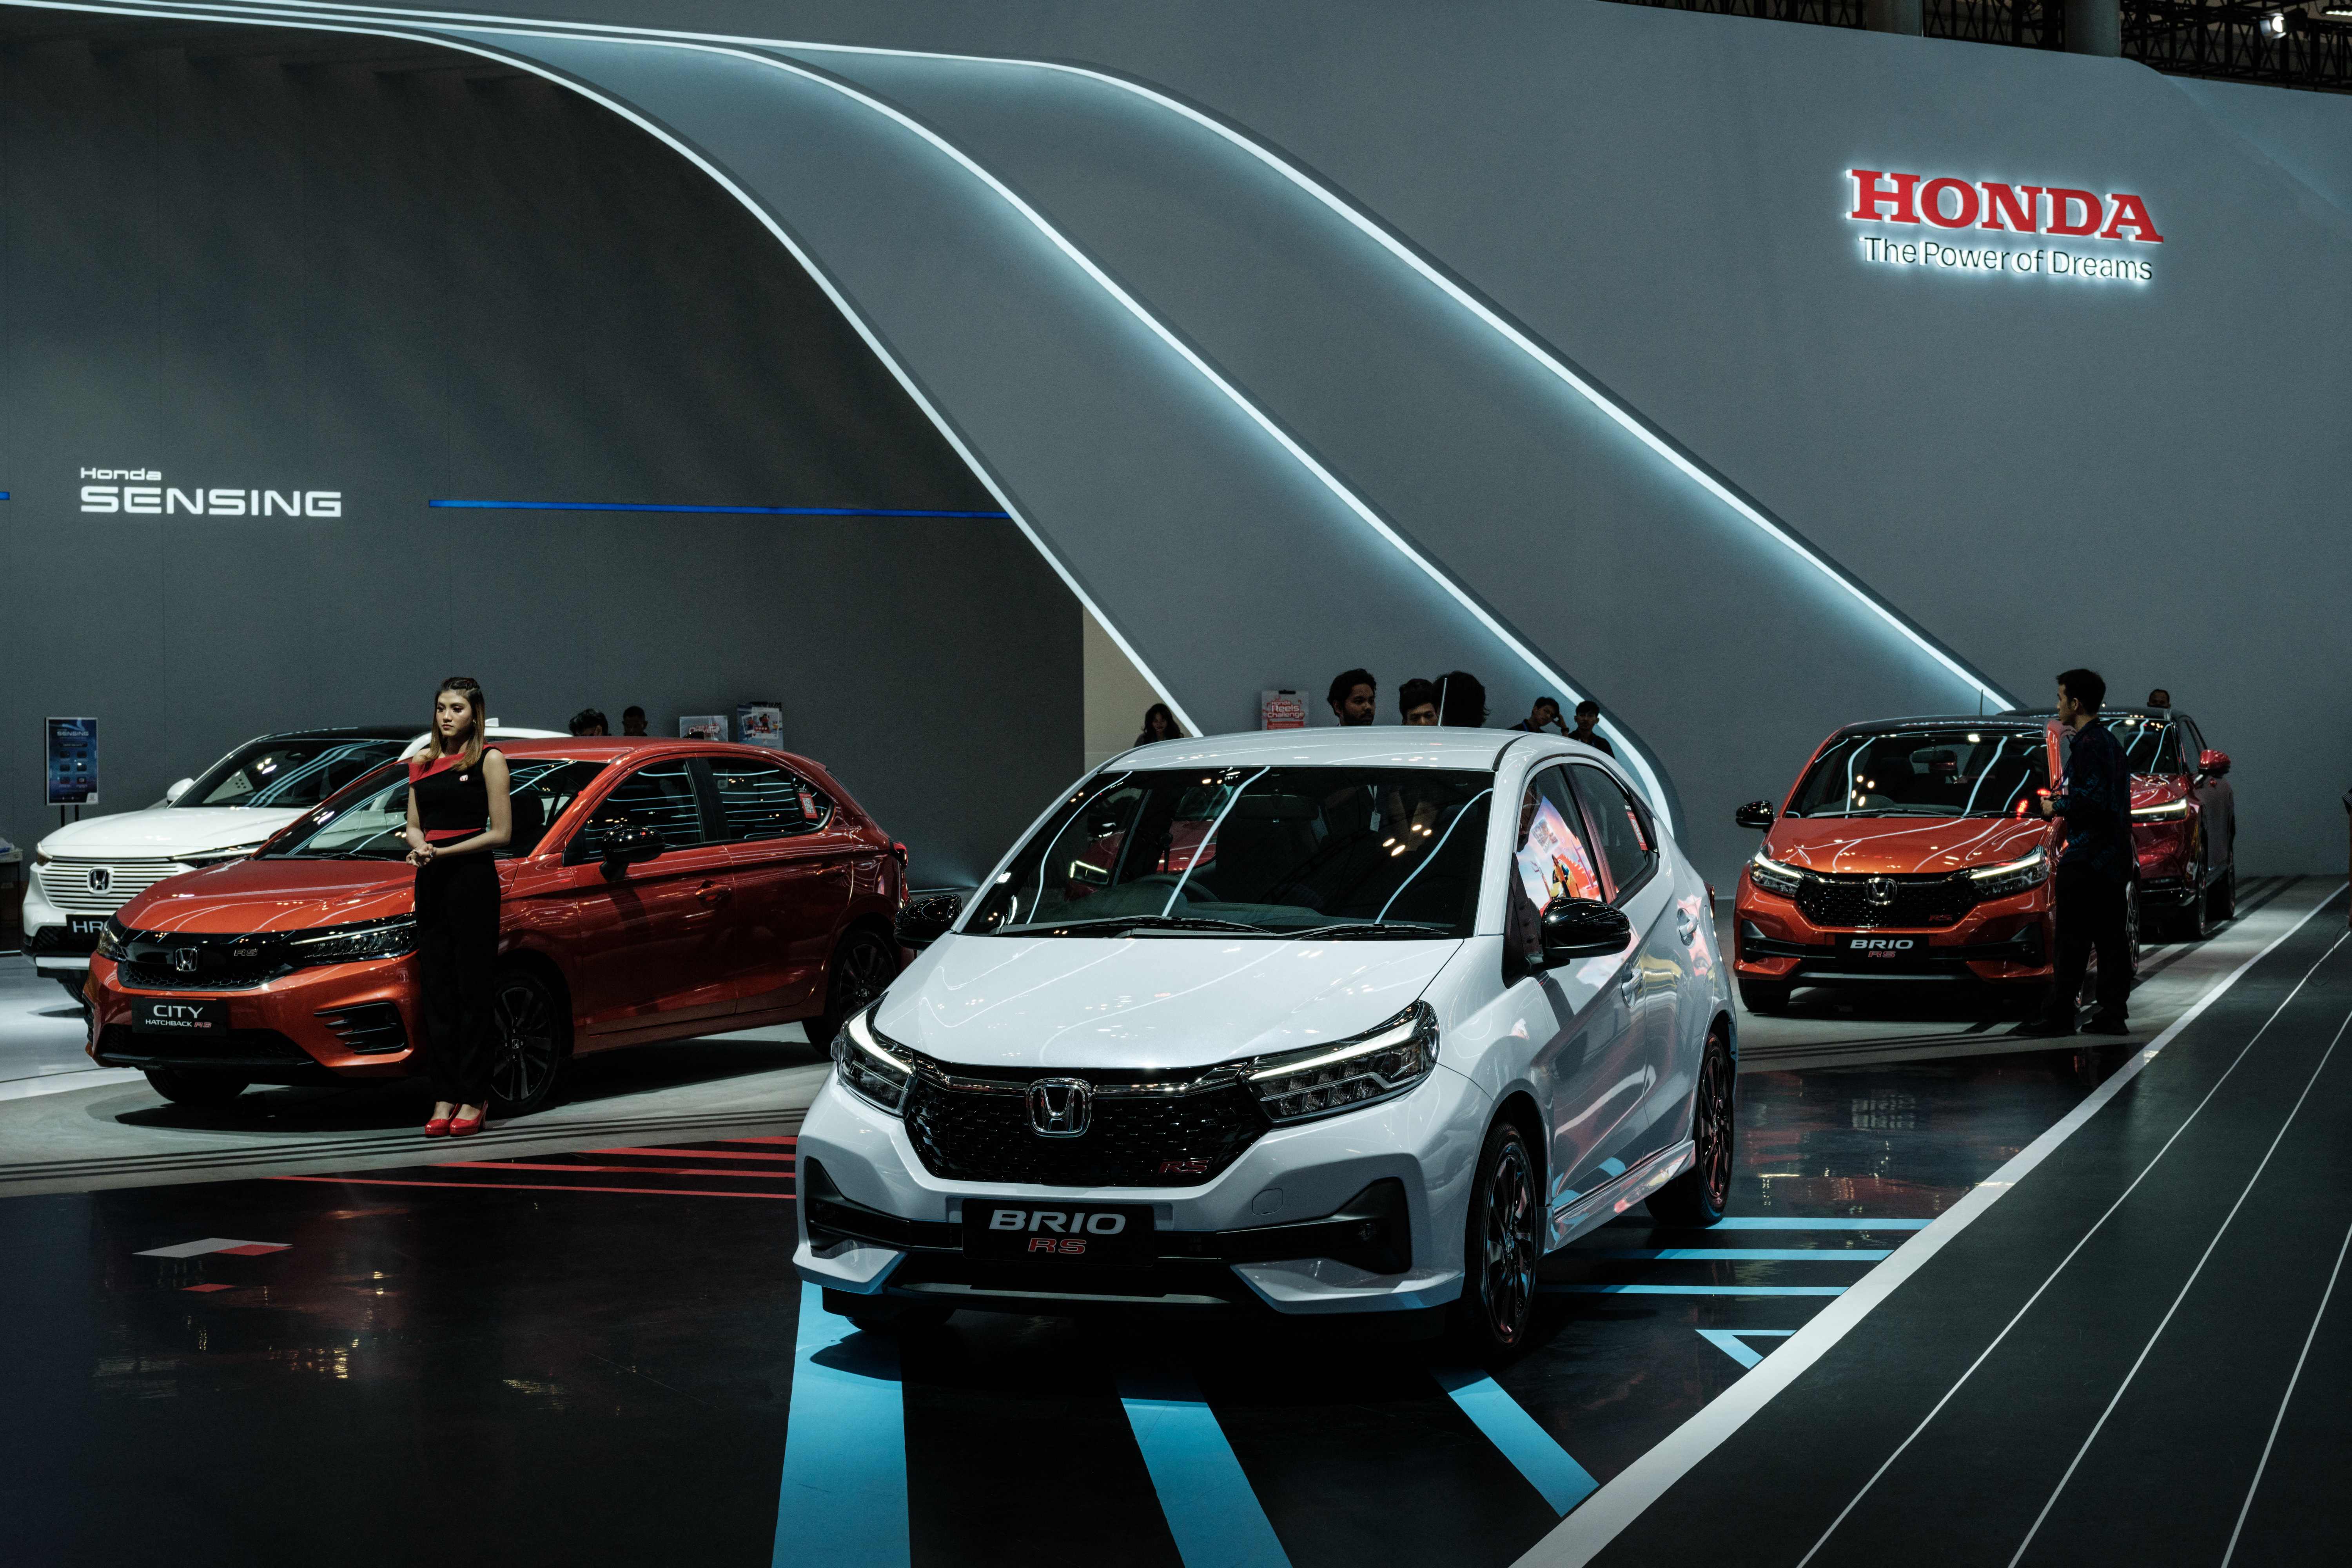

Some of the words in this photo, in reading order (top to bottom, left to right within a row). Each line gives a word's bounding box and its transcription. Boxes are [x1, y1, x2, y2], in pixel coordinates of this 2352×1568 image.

[1846, 169, 2164, 244] HONDA
[1863, 237, 1916, 265] The
[1919, 240, 2010, 270] Power
[2011, 250, 2044, 273] of
[2047, 250, 2152, 281] Dreams
[81, 467, 162, 480] Honda
[81, 486, 341, 517] SENSING
[1850, 940, 1913, 949] BRIO
[153, 1005, 203, 1019] CITY
[1158, 1158, 1212, 1174] RS
[989, 1209, 1126, 1234] BRIO
[1028, 1238, 1087, 1254] RS
